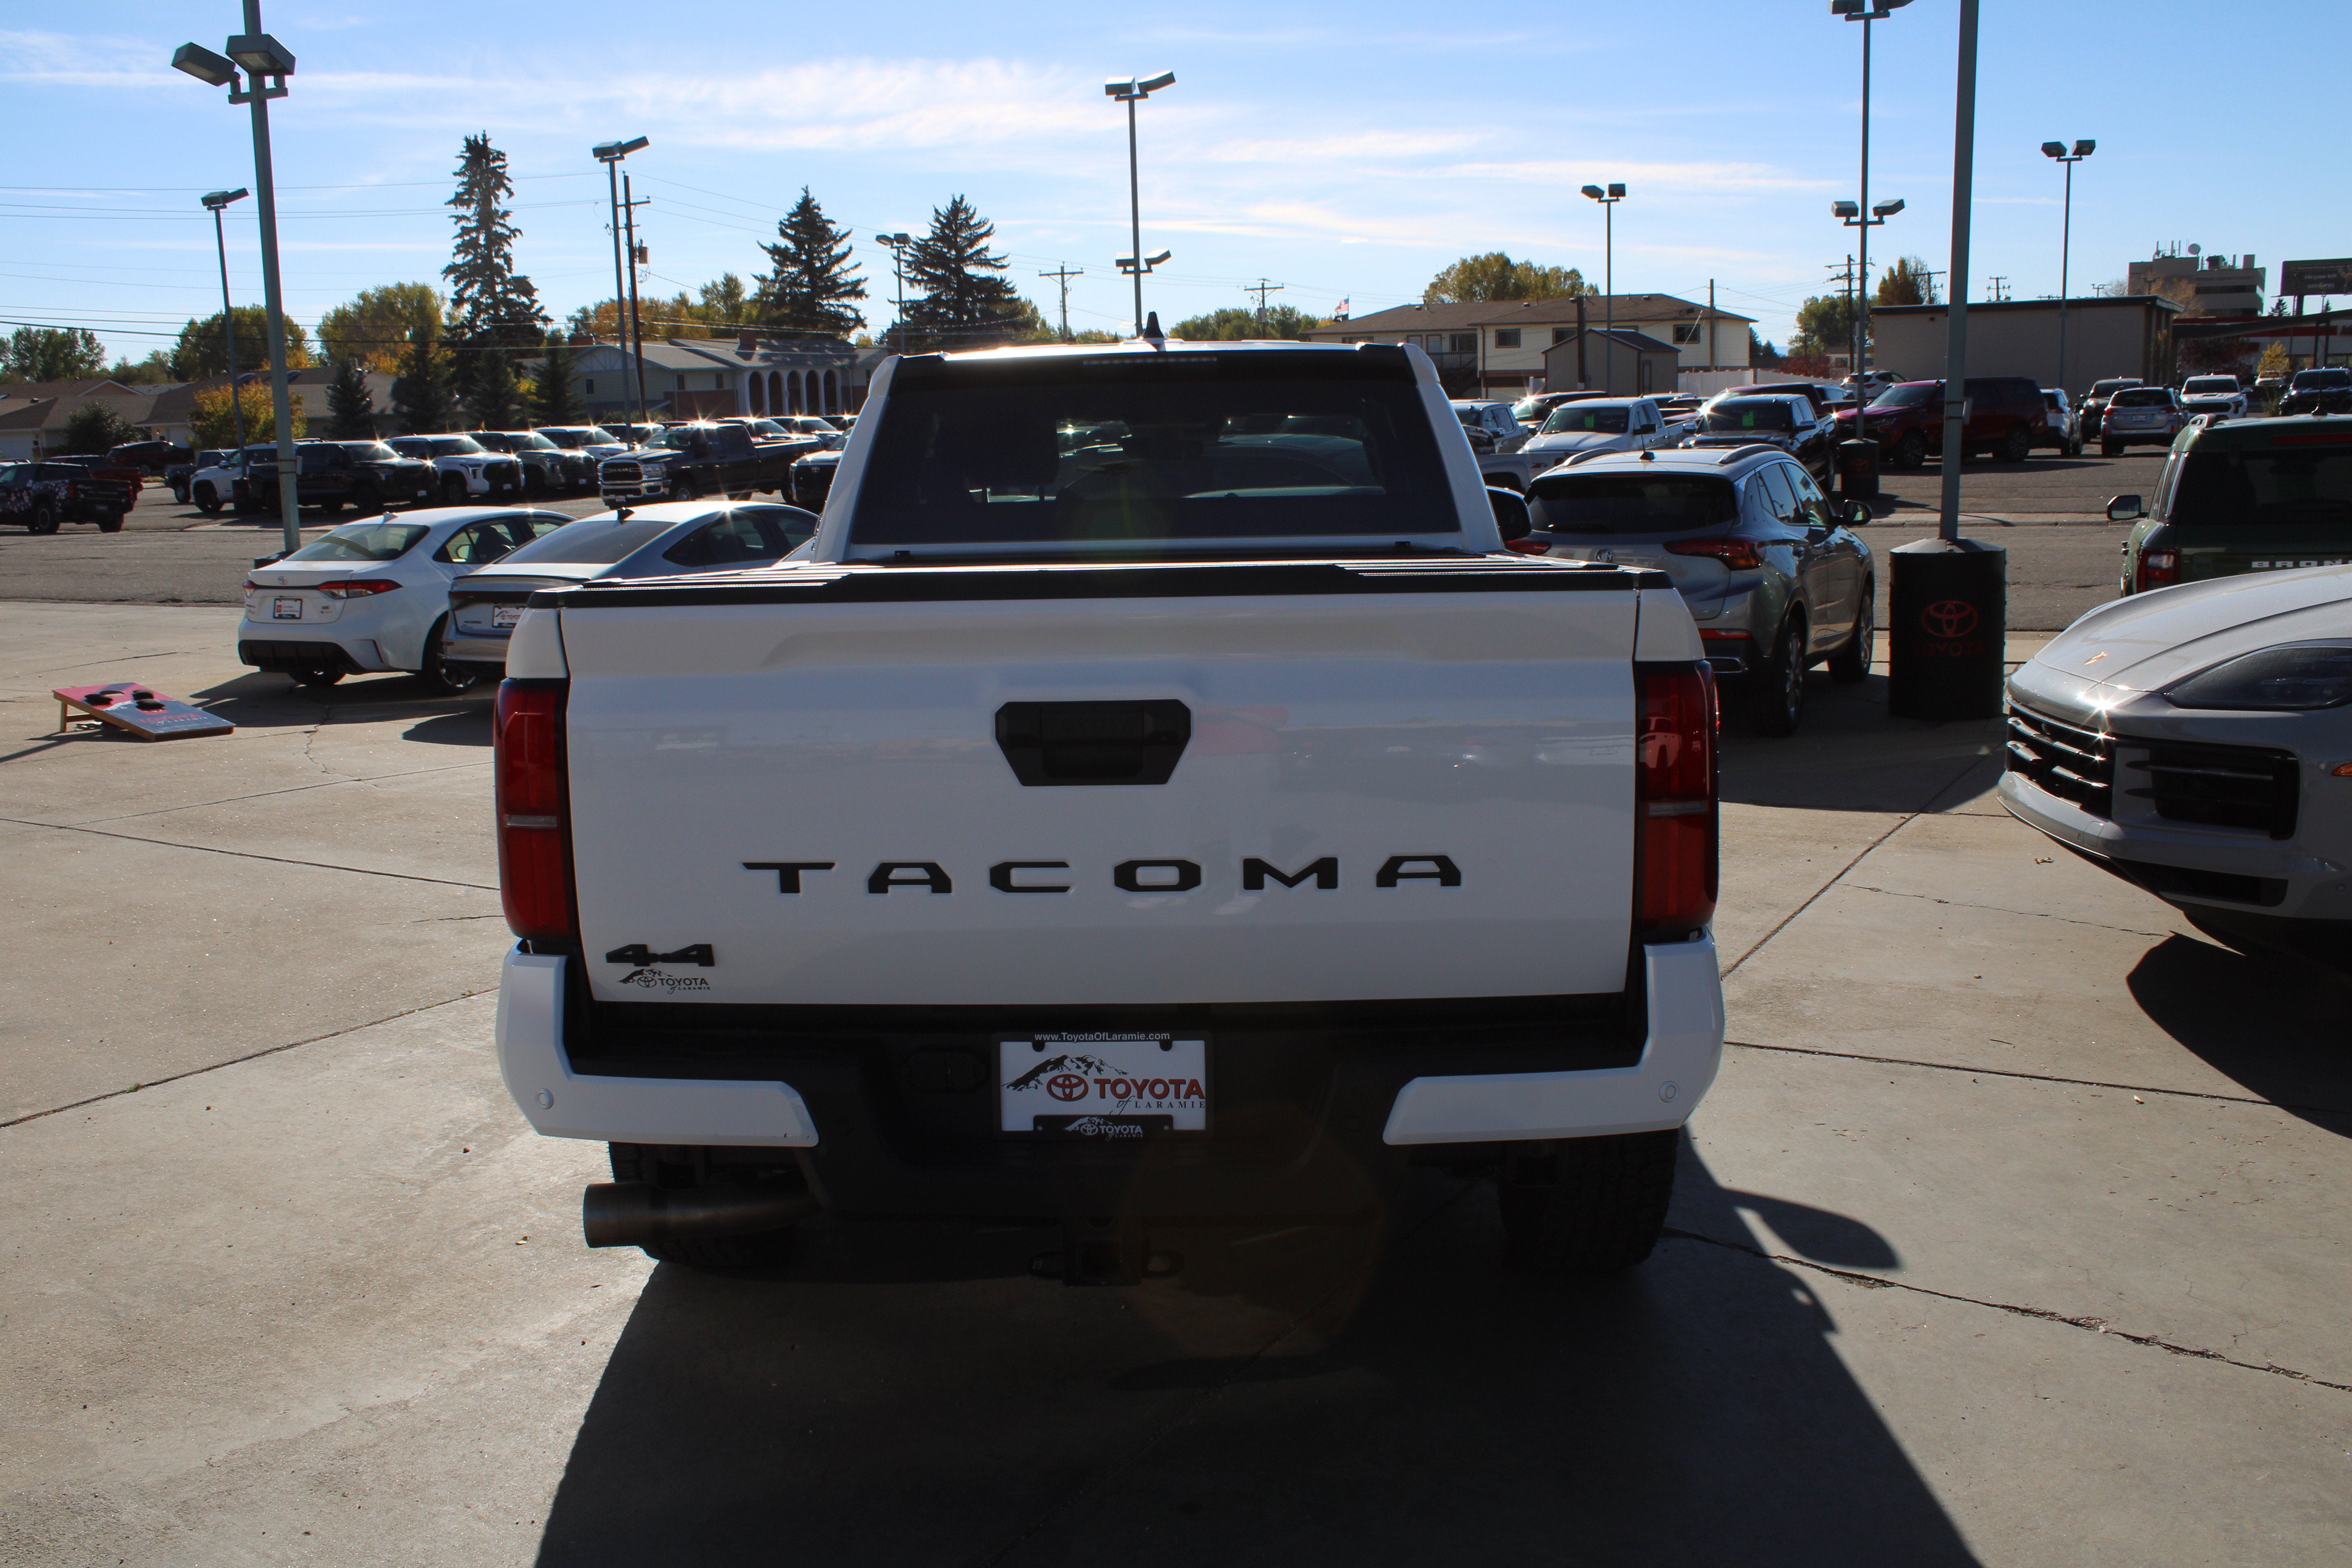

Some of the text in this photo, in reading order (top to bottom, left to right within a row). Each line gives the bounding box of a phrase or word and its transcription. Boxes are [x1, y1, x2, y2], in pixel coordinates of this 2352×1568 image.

[1912, 641, 1987, 657] TOYOTA
[135, 714, 204, 723] TOYOTA
[742, 855, 1461, 894] TACOMA
[658, 978, 709, 986] TOYOTA
[668, 984, 678, 995] of
[1034, 1032, 1170, 1042] www.ToyotaOfLaramie.com
[1094, 1078, 1205, 1099] TOYOTA
[1109, 1096, 1135, 1115] of
[1099, 1125, 1143, 1134] TOYOTA
[1105, 1132, 1115, 1142] of
